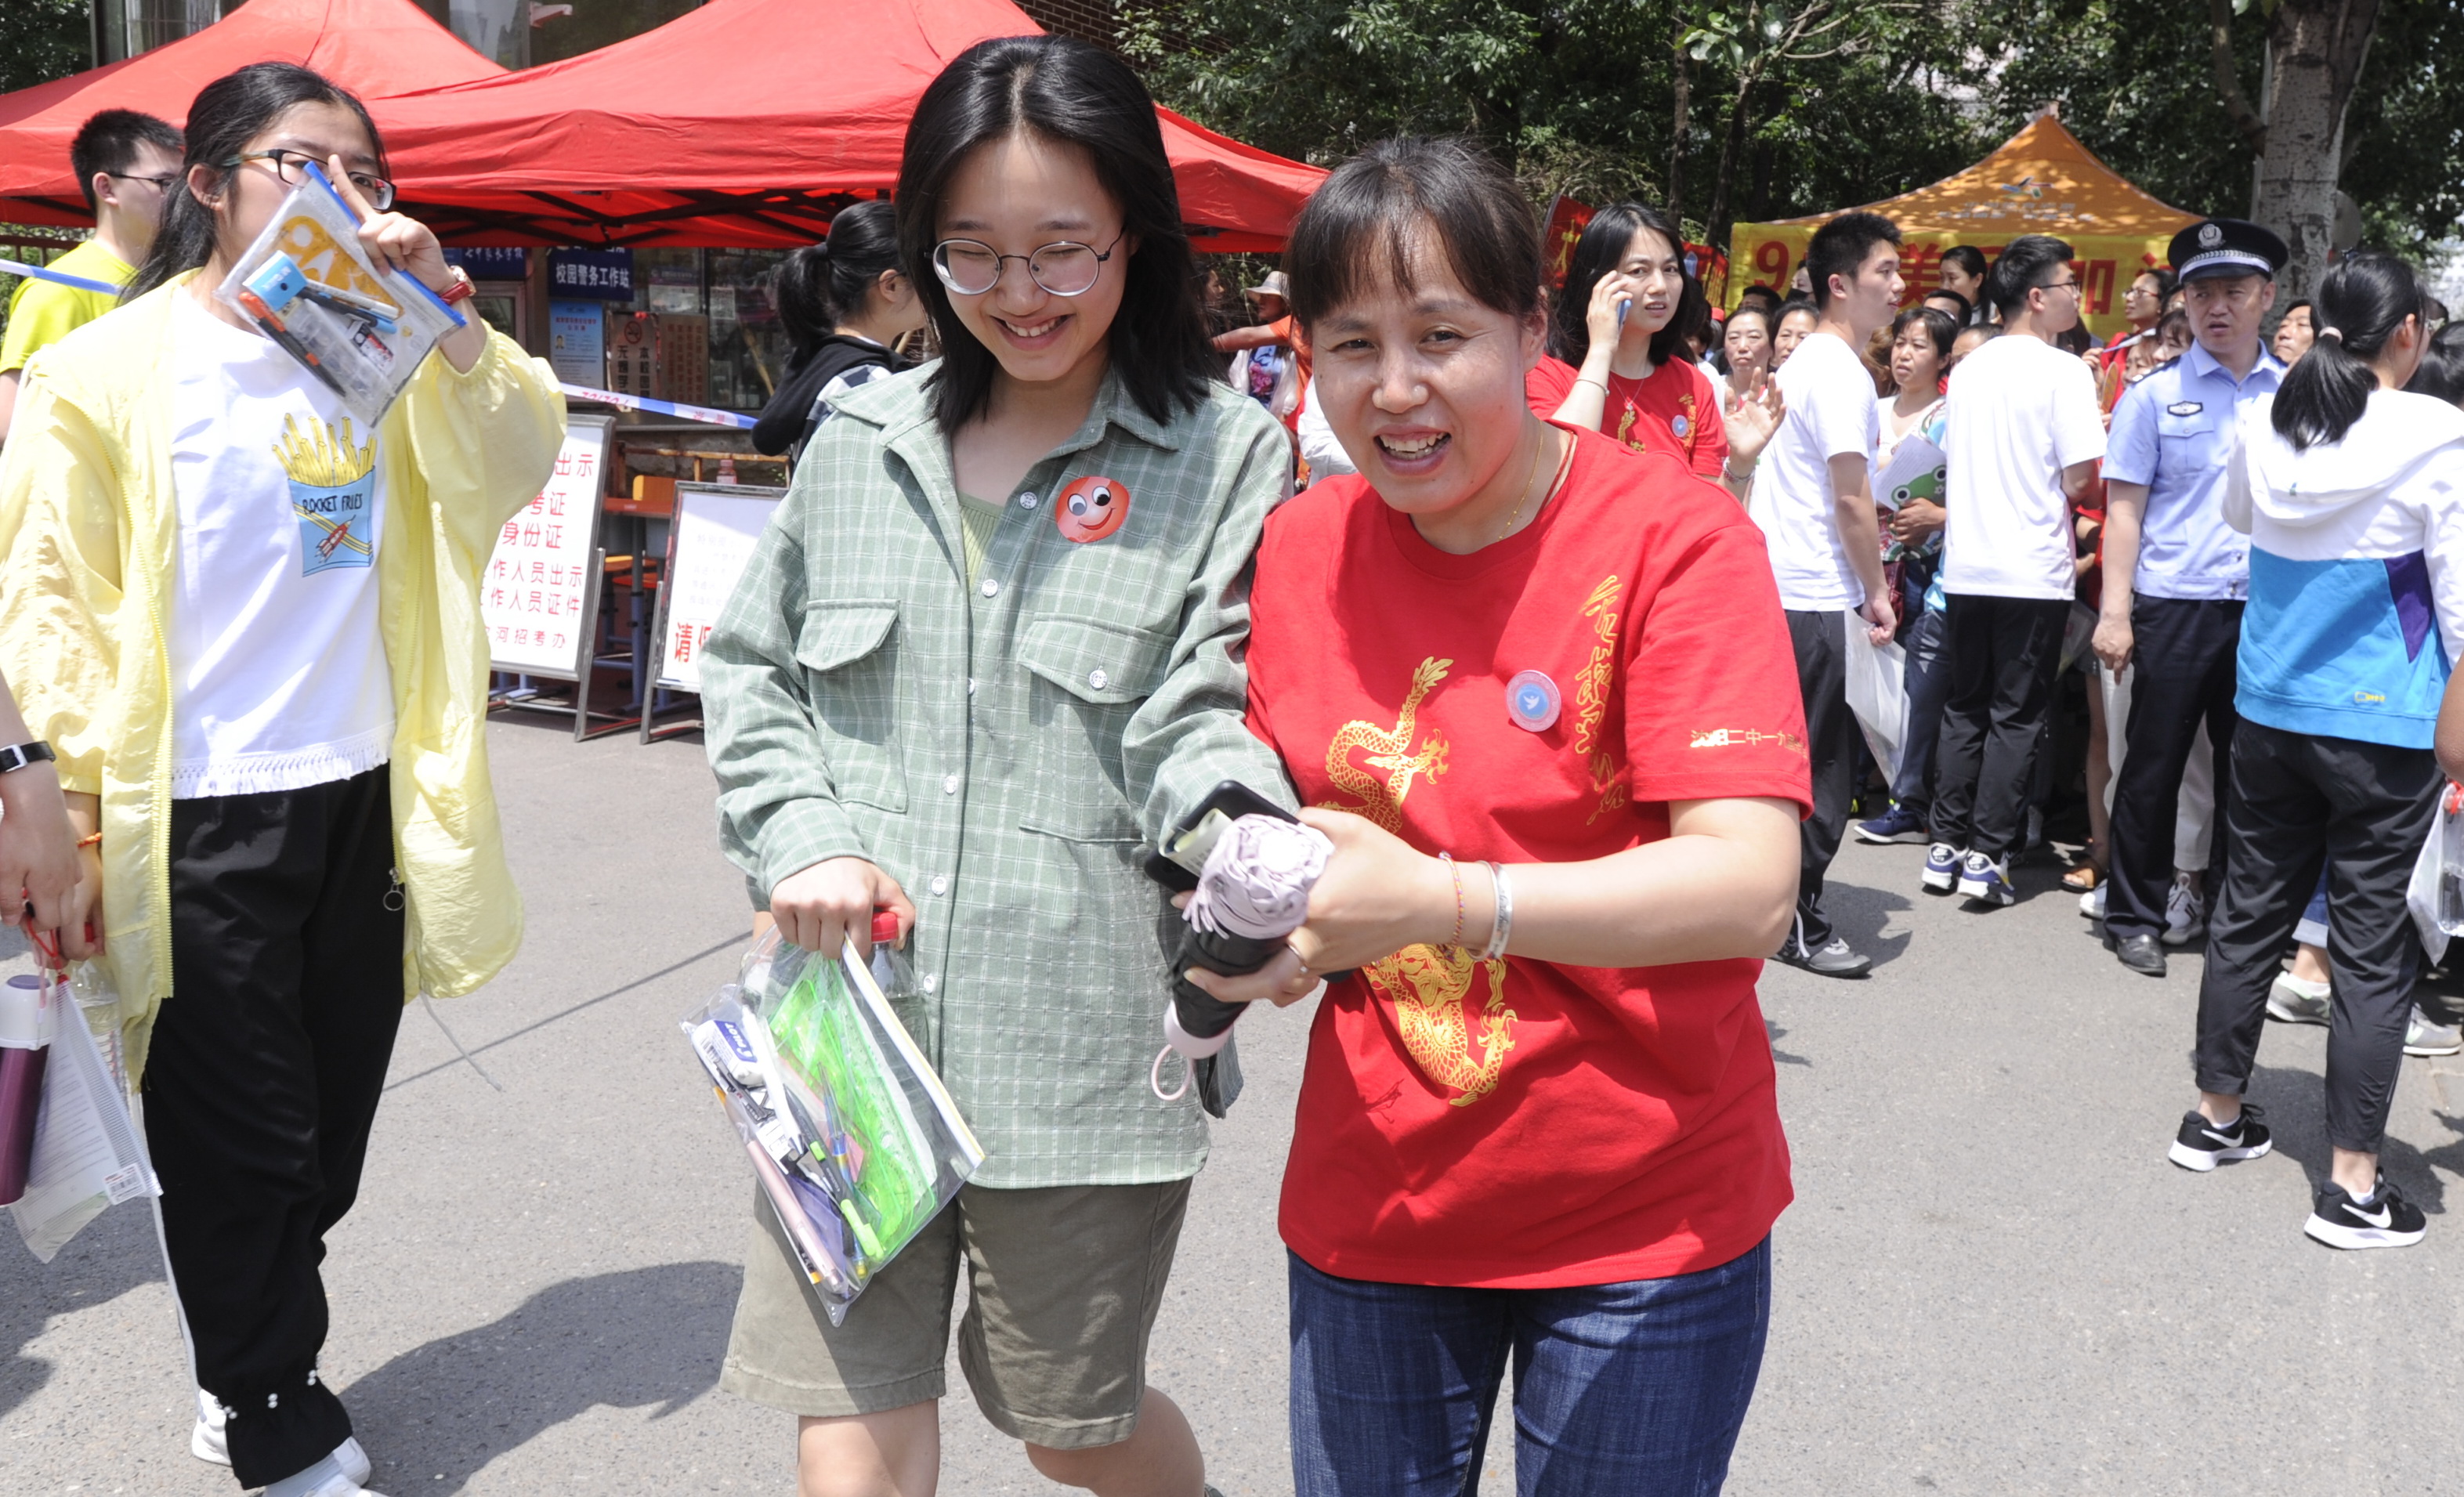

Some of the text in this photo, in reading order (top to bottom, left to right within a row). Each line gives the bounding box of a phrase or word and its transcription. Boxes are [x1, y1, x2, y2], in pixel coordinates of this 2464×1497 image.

[555, 262, 630, 288] 校园警务工作站
[554, 451, 594, 477] 出示
[302, 495, 338, 512] ROCKET
[519, 490, 566, 515] 考证
[502, 521, 563, 549] 身份证
[483, 558, 583, 588] 作人员出示
[479, 587, 581, 617] 作人员证件
[724, 1022, 747, 1048] PILOT
